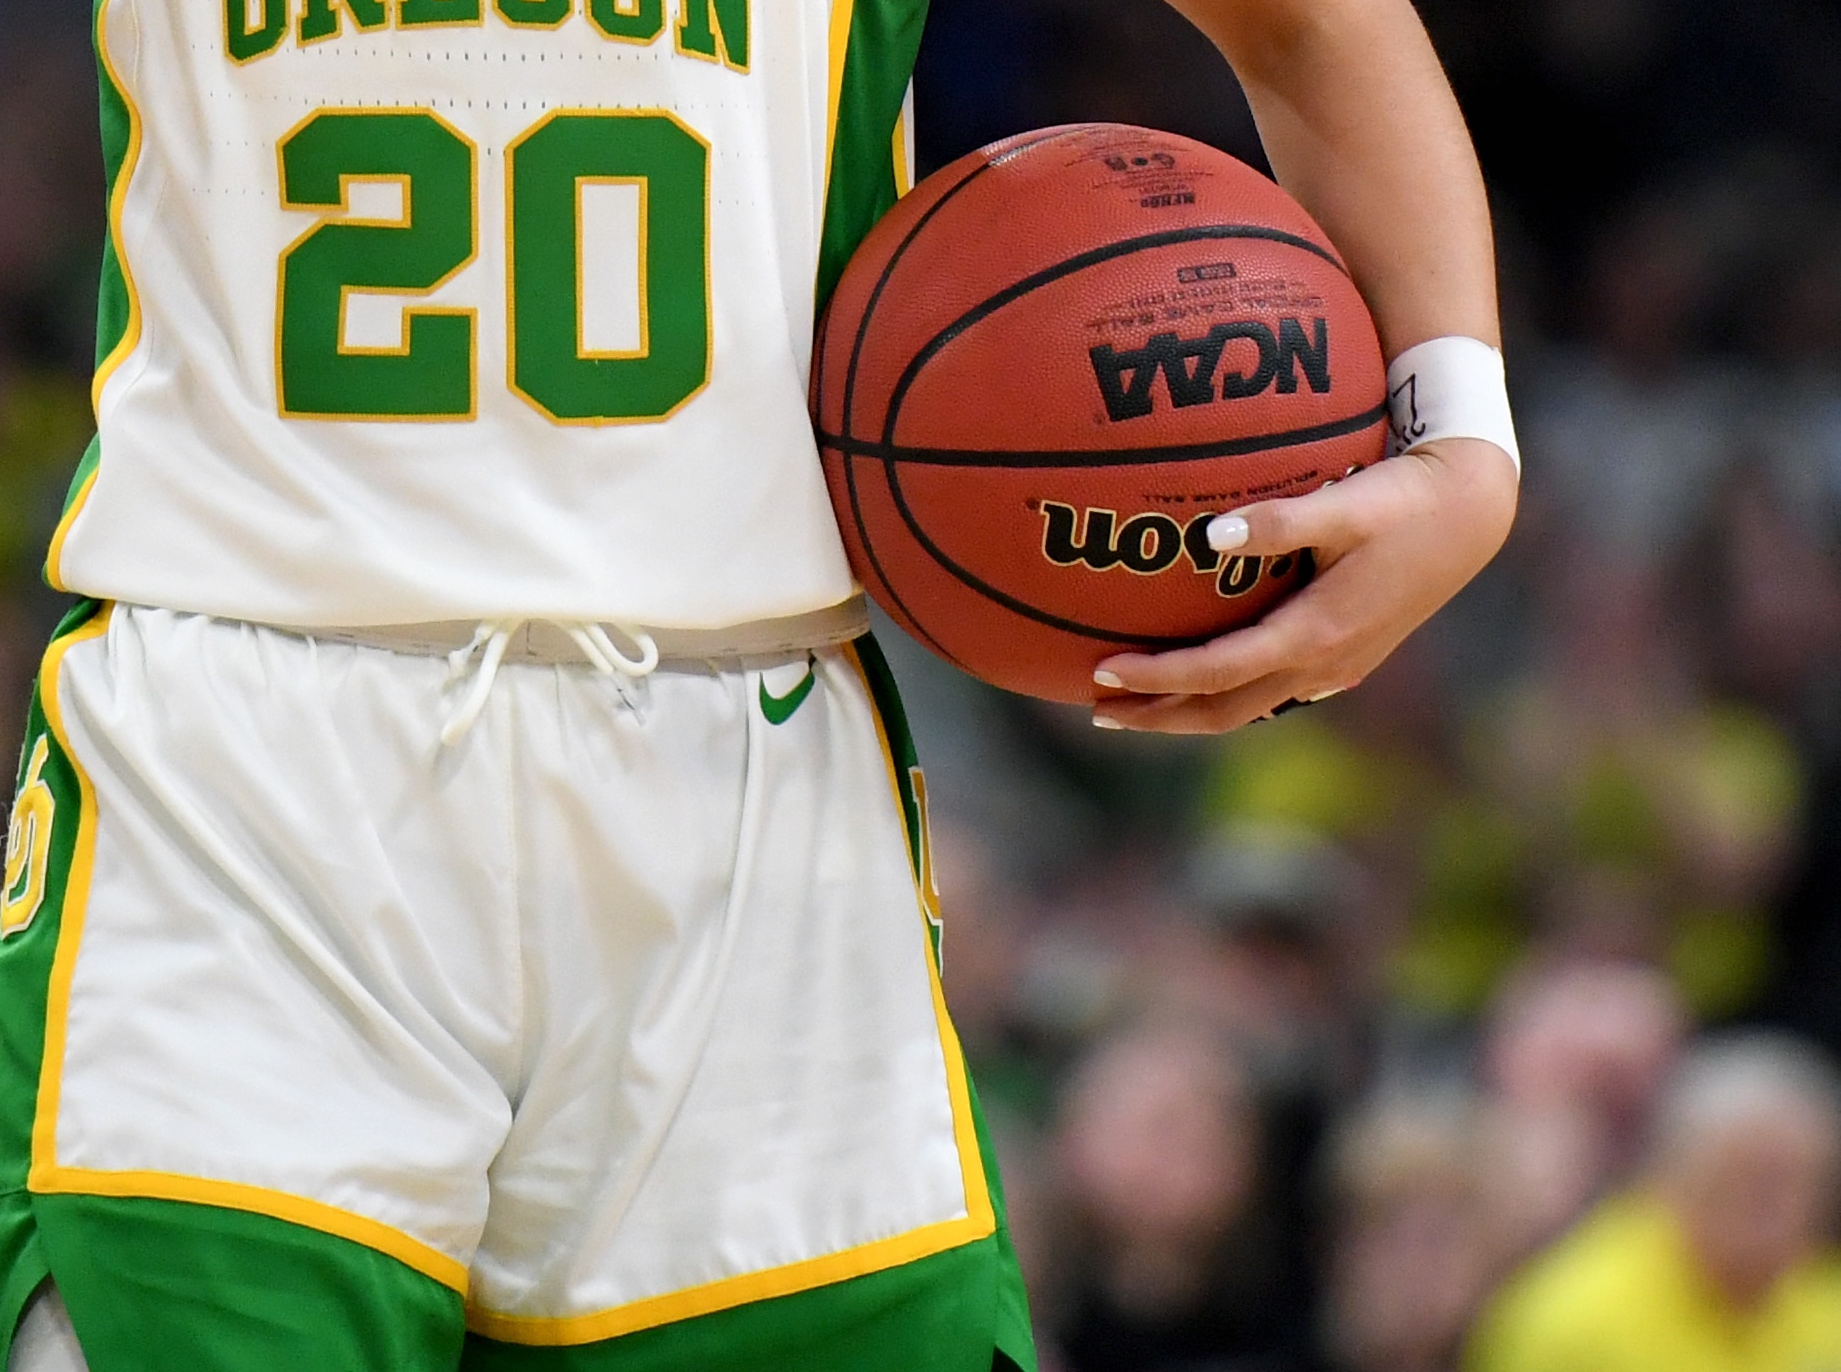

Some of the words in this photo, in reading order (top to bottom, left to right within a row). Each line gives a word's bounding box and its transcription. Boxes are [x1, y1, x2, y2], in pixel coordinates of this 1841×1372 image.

[275, 106, 712, 428] 20
[1089, 316, 1330, 423] NCAA
[1039, 494, 1324, 598] lson
